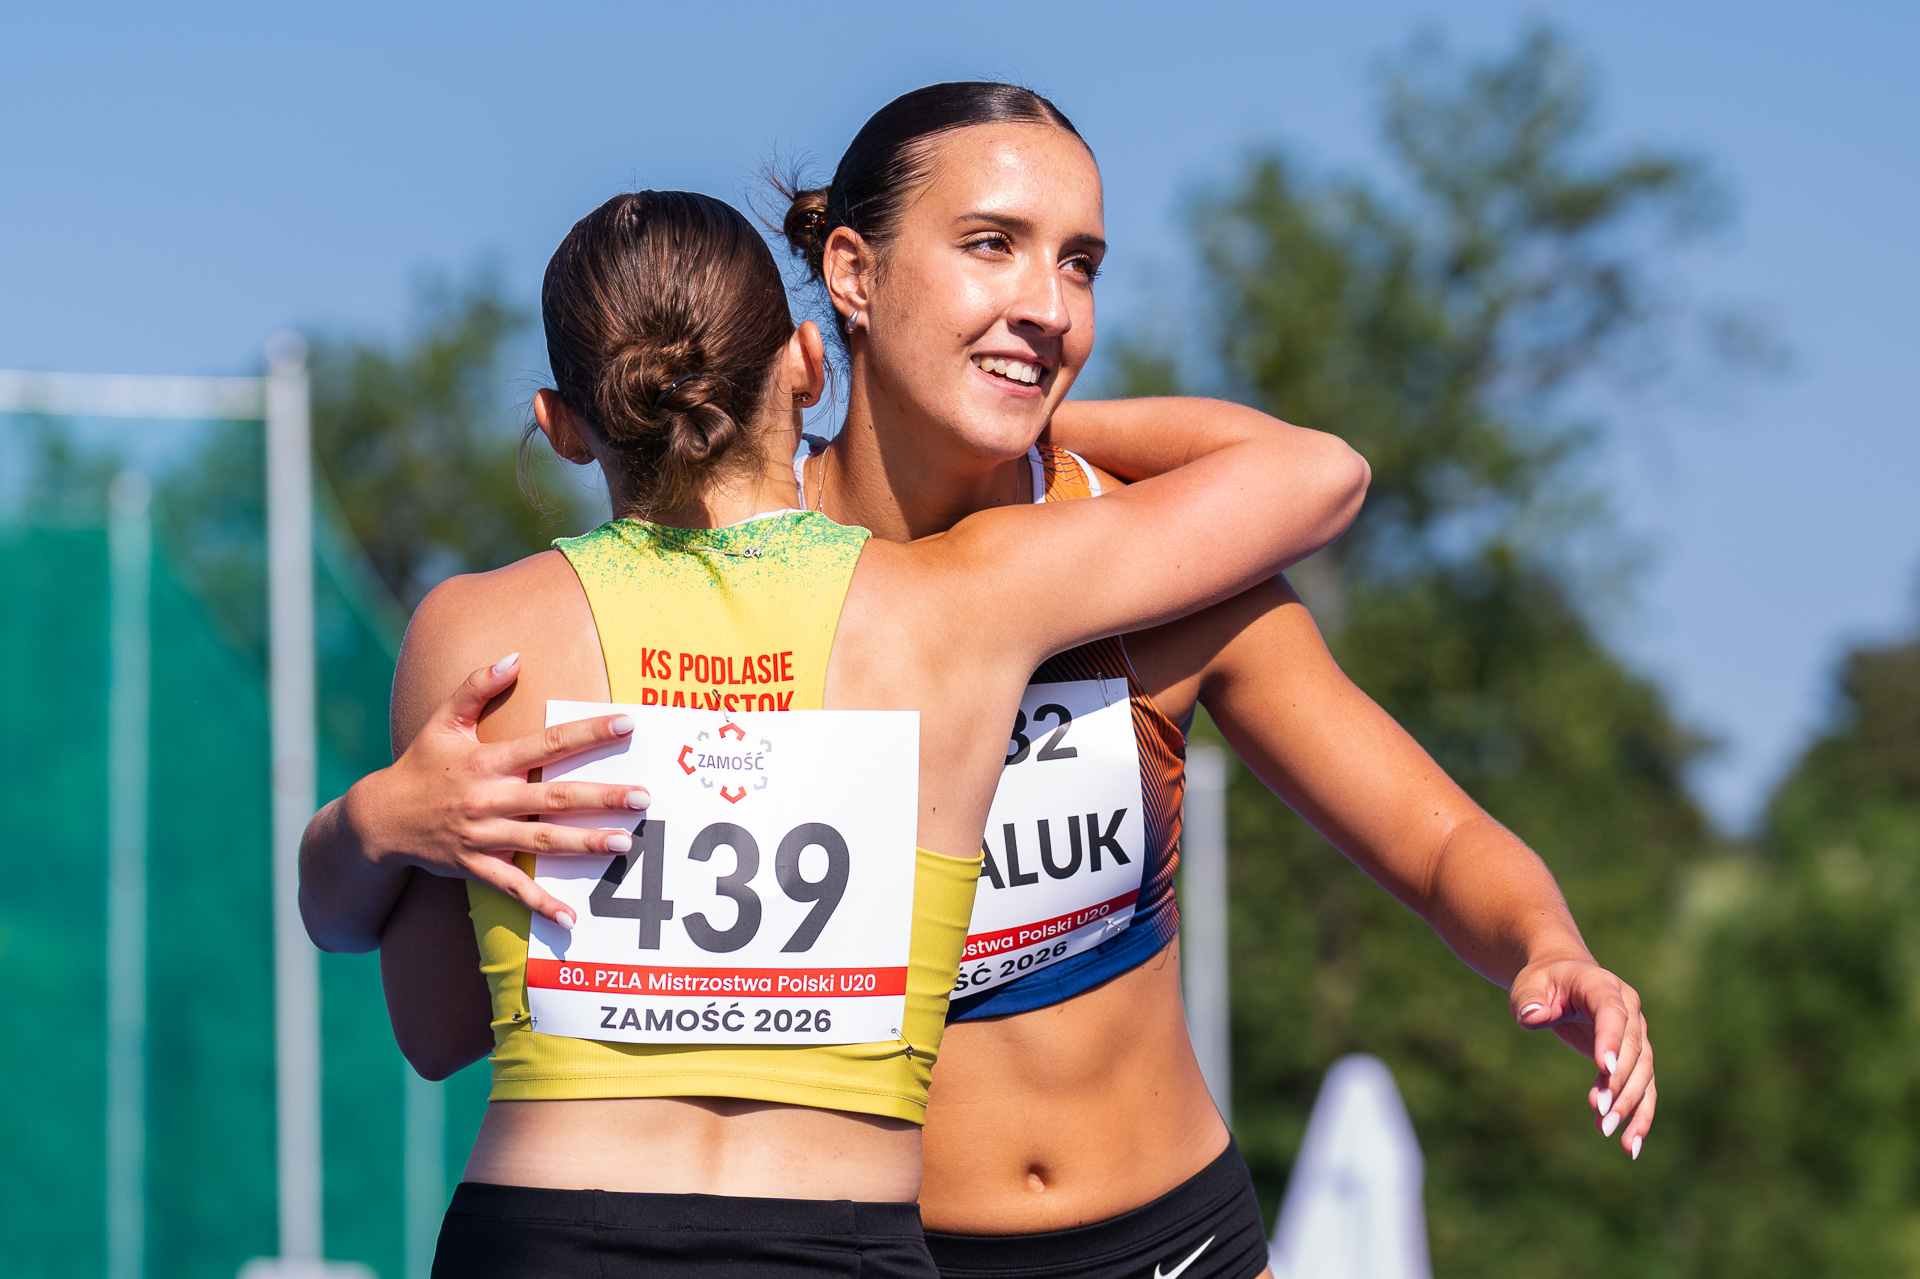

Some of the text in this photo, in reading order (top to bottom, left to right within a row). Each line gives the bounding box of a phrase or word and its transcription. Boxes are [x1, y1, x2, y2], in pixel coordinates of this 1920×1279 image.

[641, 647, 794, 685] KS PODLASIE
[698, 752, 764, 770] ZAMOŚĆ
[589, 820, 850, 953] 439
[1019, 917, 1071, 944] Polski
[1076, 904, 1110, 925] U20
[1000, 941, 1068, 978] 2026
[559, 967, 876, 992] 80. PZLA Mistrzostwa Polski U20
[600, 1002, 831, 1032] ZAMOŚĆ 2026
